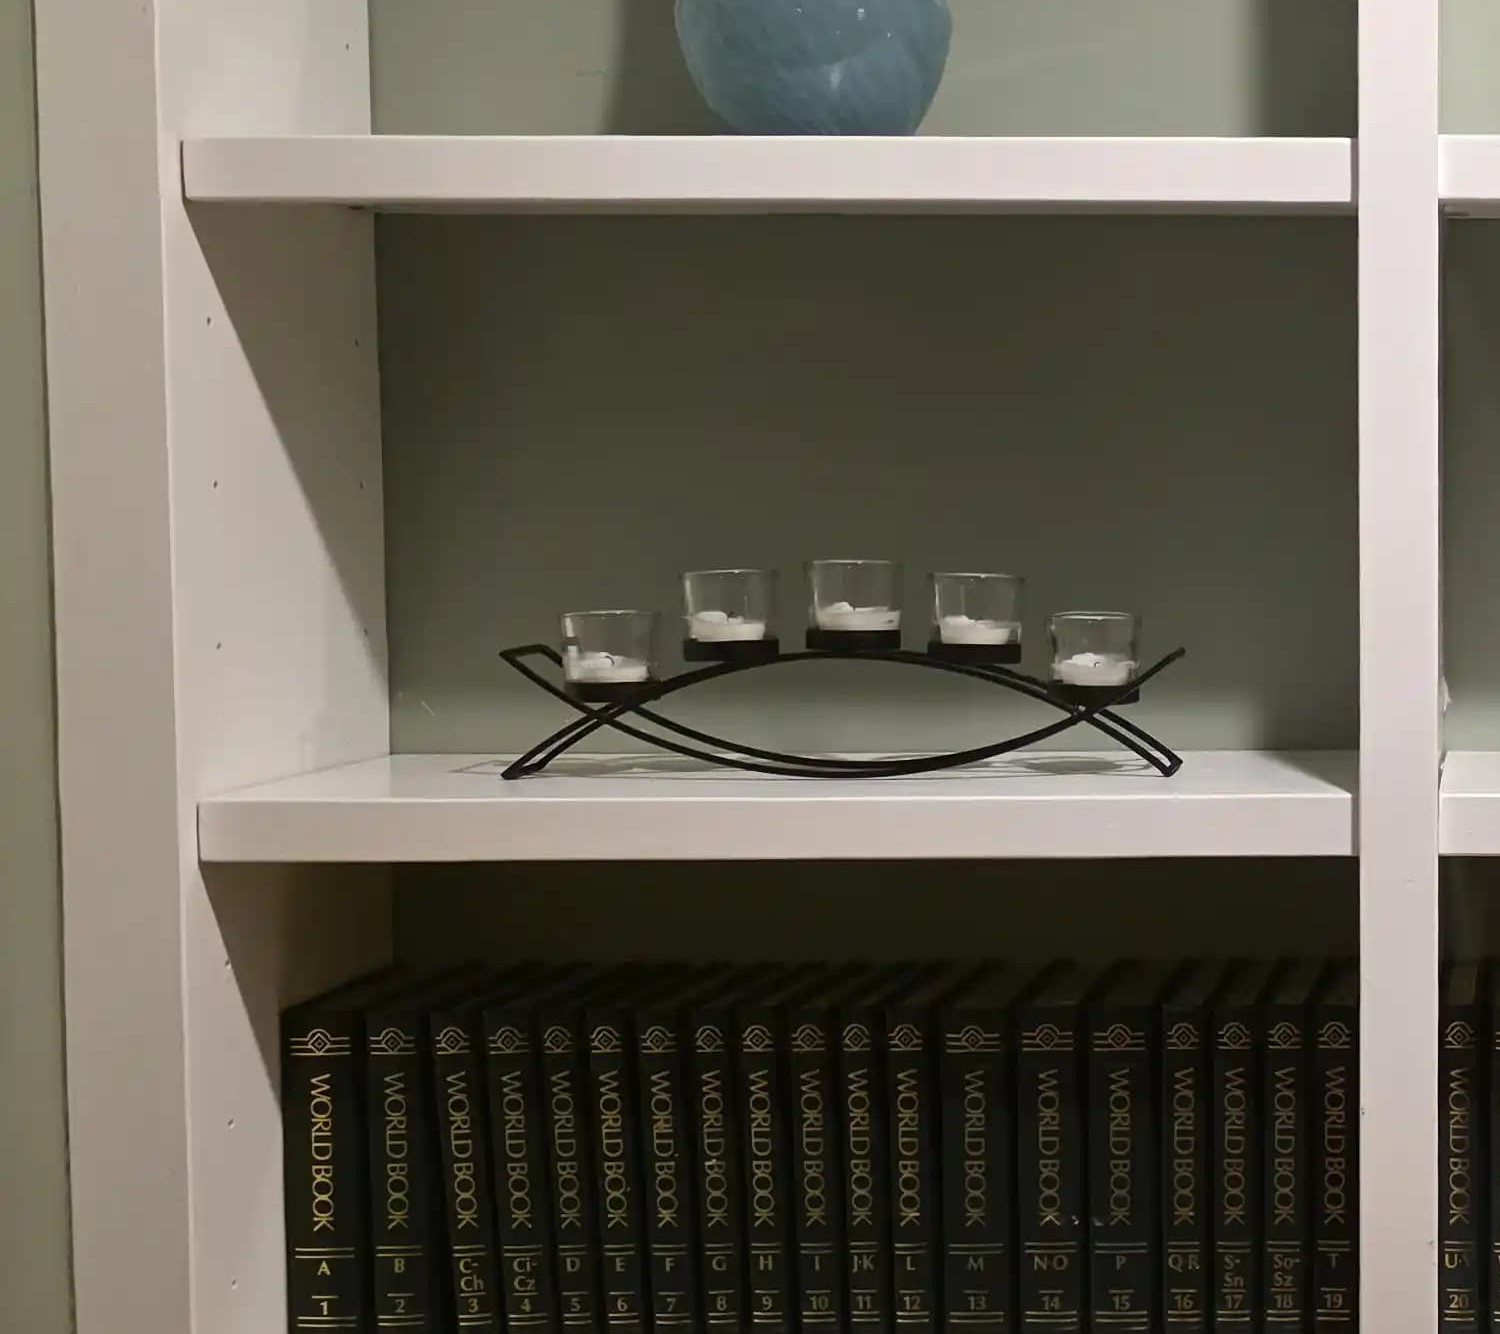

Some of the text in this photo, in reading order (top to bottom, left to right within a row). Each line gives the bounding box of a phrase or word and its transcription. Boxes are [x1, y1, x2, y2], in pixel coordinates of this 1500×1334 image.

[309, 1072, 335, 1233] WORLD BOOK
[382, 1072, 410, 1231] WORLD BOOK
[445, 1071, 479, 1230] WORLD BOOK
[500, 1071, 532, 1230] WORLD BOOK
[550, 1070, 581, 1229] WORLD BOOK
[598, 1070, 629, 1229] WORLD BOOK
[650, 1069, 680, 1229] WORLD BOOK
[700, 1069, 728, 1228] WORLD BOOK
[747, 1069, 775, 1228] WORLD BOOK
[799, 1068, 827, 1228] WORLD BOOK
[846, 1068, 874, 1228] WORLD BOOK
[896, 1068, 920, 1228] WORLD BOOK
[316, 1260, 332, 1277] A
[393, 1258, 406, 1274] B
[458, 1257, 479, 1275] C-
[566, 1257, 581, 1273] D
[615, 1257, 626, 1273] E
[758, 1256, 773, 1271] H
[906, 1256, 916, 1271] L
[967, 1256, 984, 1272] M
[460, 1275, 484, 1292] Ch
[513, 1275, 536, 1292] Cz
[1223, 1273, 1244, 1288] Sn
[320, 1300, 330, 1317] 1
[394, 1298, 406, 1314] 2
[467, 1298, 480, 1314] 3
[520, 1298, 532, 1314] 4
[762, 1296, 772, 1311] 9
[903, 1296, 921, 1311] 12
[1112, 1295, 1131, 1311] 15
[1174, 1294, 1194, 1310] 16
[1225, 1294, 1243, 1310] 17
[1323, 1294, 1344, 1309] 19
